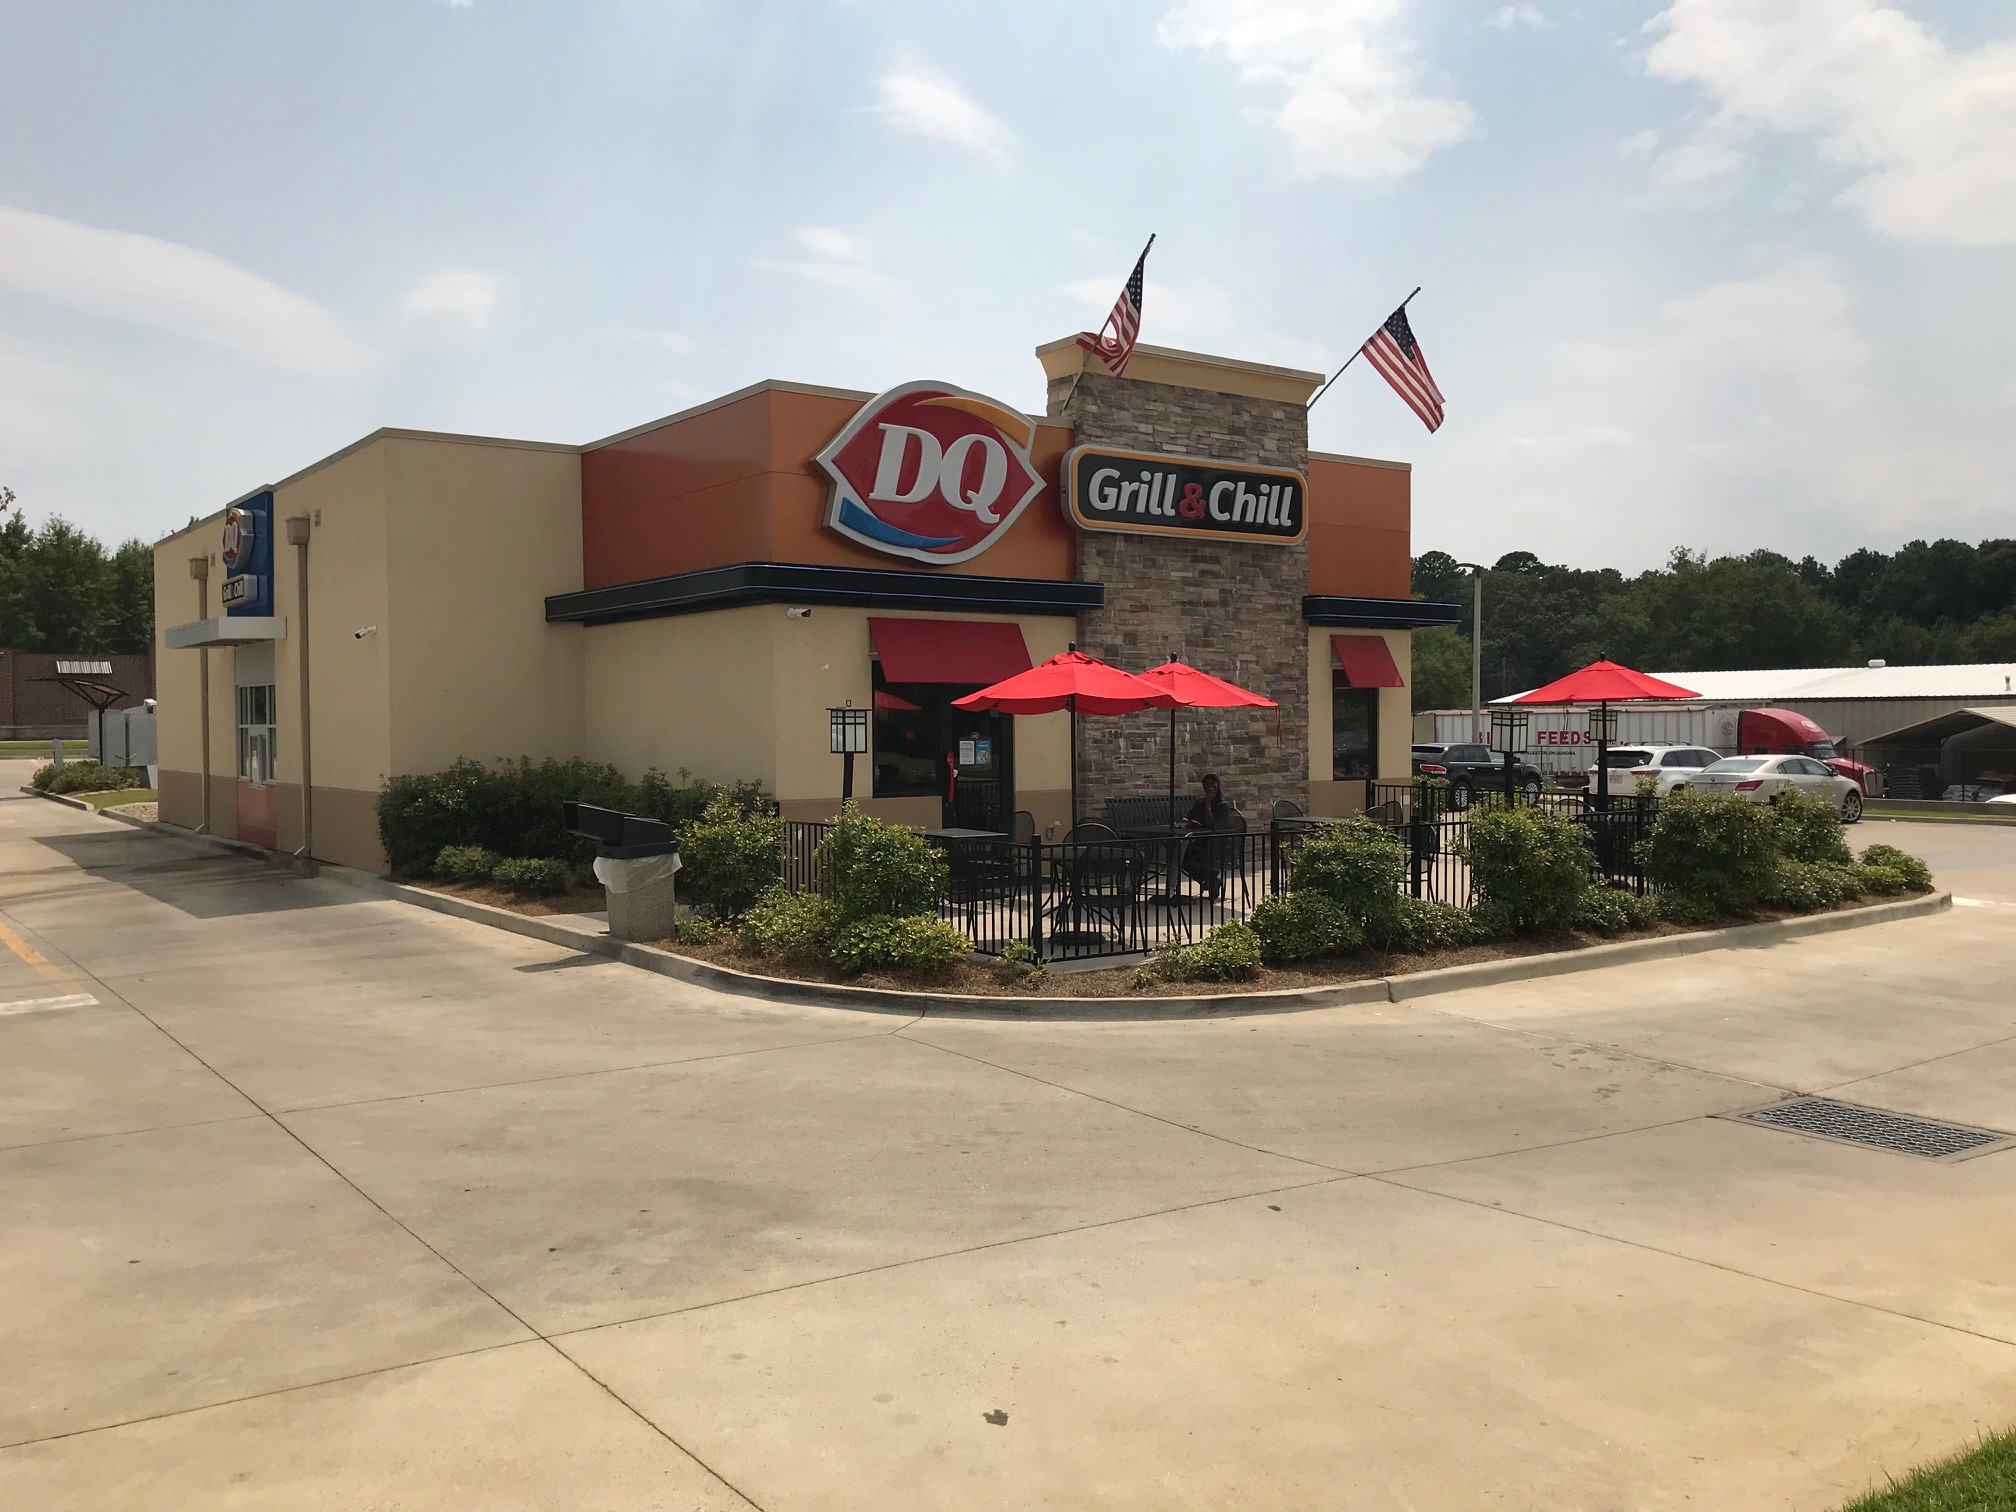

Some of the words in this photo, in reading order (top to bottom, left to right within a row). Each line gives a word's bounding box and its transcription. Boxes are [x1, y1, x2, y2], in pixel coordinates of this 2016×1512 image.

[869, 422, 1007, 524] DQ
[1088, 468, 1177, 517] Grill
[1208, 480, 1294, 527] Chill
[1537, 731, 1592, 745] FEEDS
